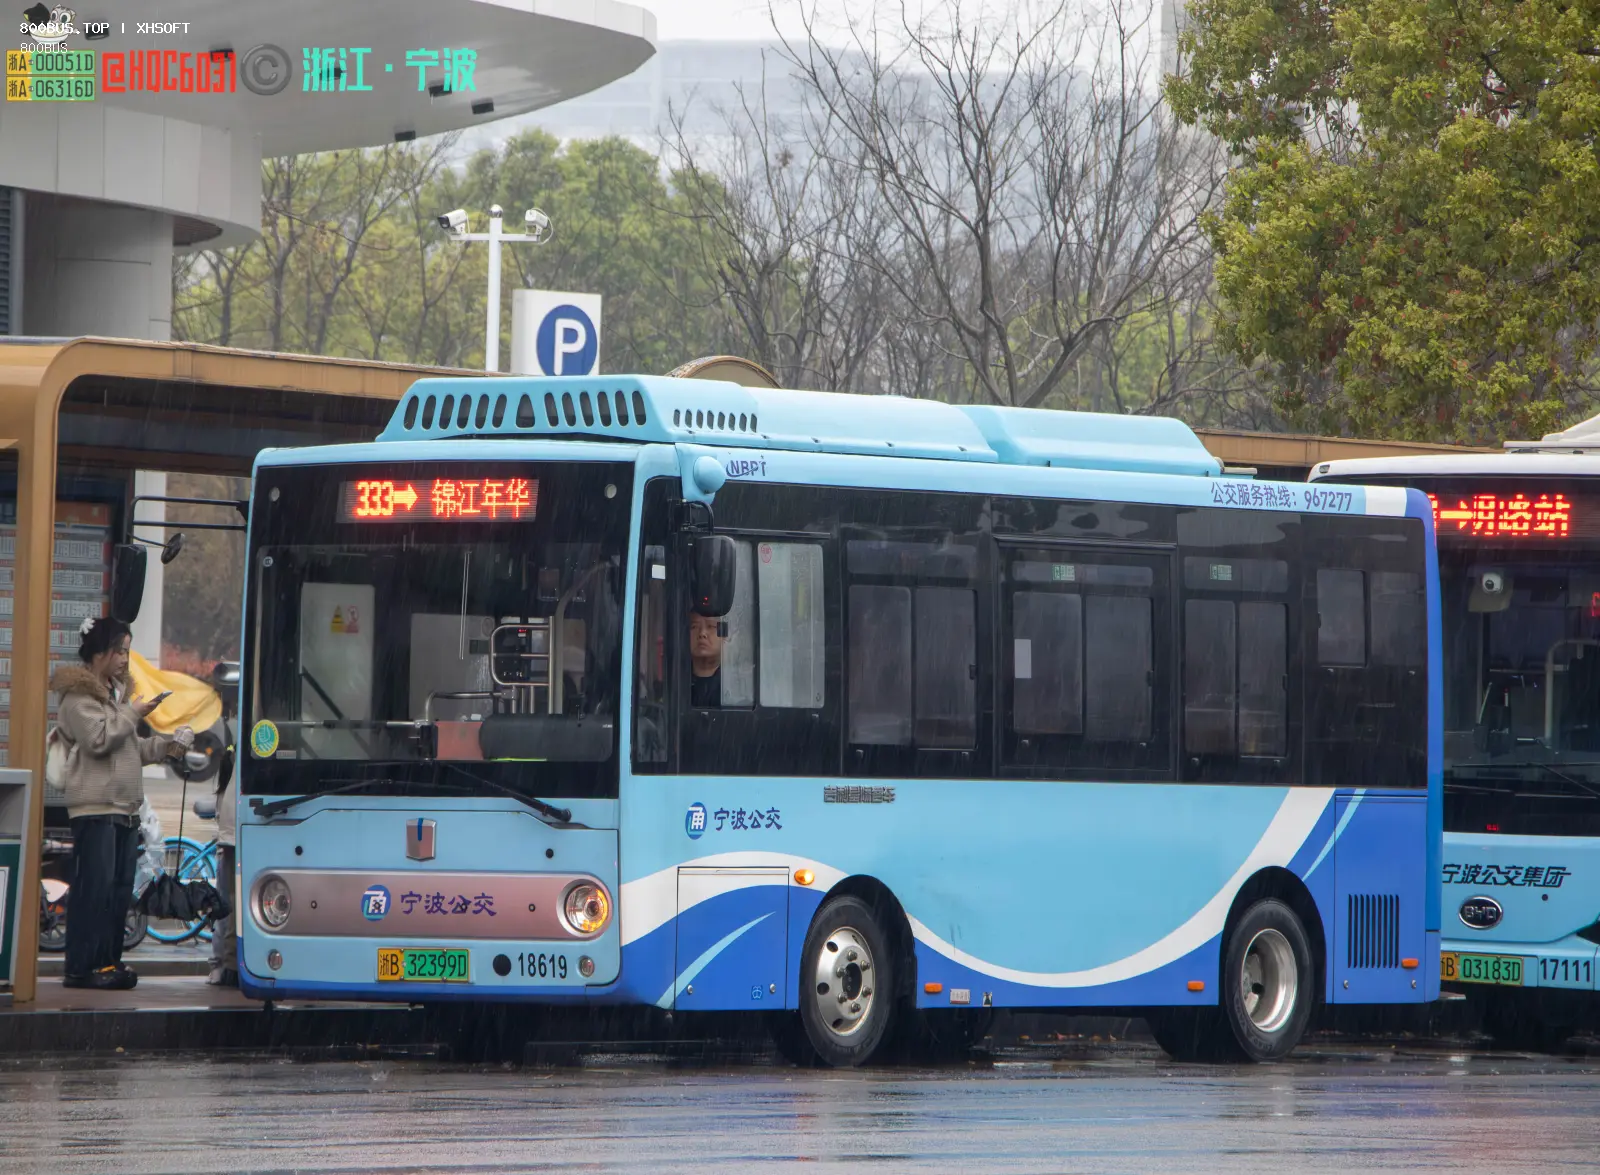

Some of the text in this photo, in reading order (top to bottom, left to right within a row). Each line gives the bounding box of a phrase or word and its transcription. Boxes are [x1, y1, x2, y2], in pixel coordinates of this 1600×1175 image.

[553, 317, 587, 376] P
[355, 478, 531, 518] 333 锦江年华
[713, 806, 783, 831] 宁波公交
[1441, 863, 1572, 888] 宁波公交集团
[400, 890, 497, 917] 宁波公交
[1464, 905, 1497, 921] BYD
[517, 952, 568, 979] 18619
[1540, 958, 1591, 983] 17111
